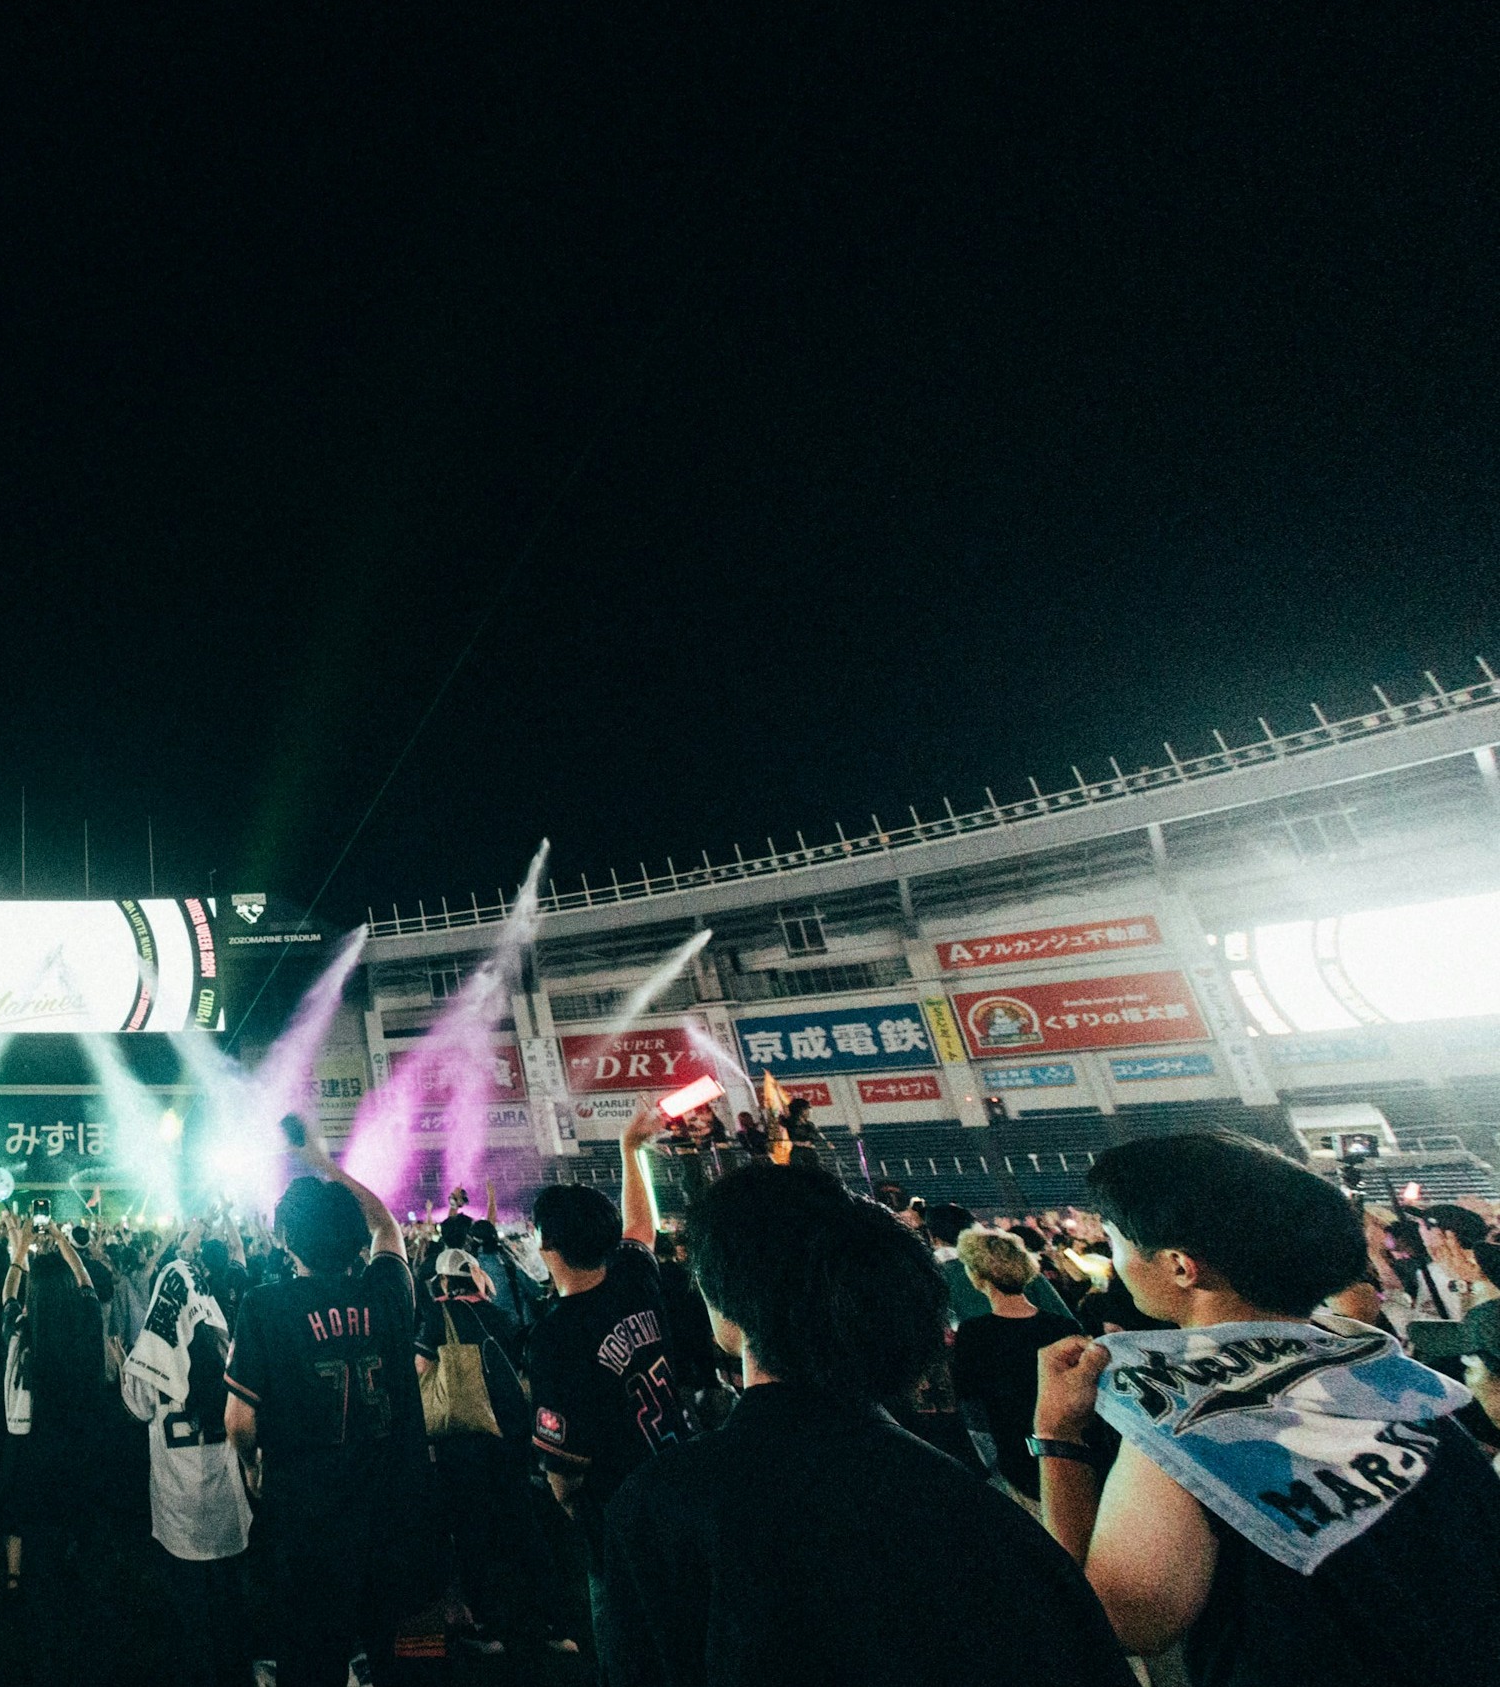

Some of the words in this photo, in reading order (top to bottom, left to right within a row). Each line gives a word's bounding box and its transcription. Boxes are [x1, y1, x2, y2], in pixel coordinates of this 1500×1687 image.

[283, 933, 321, 943] STADIUM
[613, 1038, 666, 1052] SUPER
[743, 1016, 928, 1064] 京成電鉄
[596, 1108, 633, 1119] Group
[307, 1306, 371, 1342] HORI
[314, 1354, 393, 1443] 75
